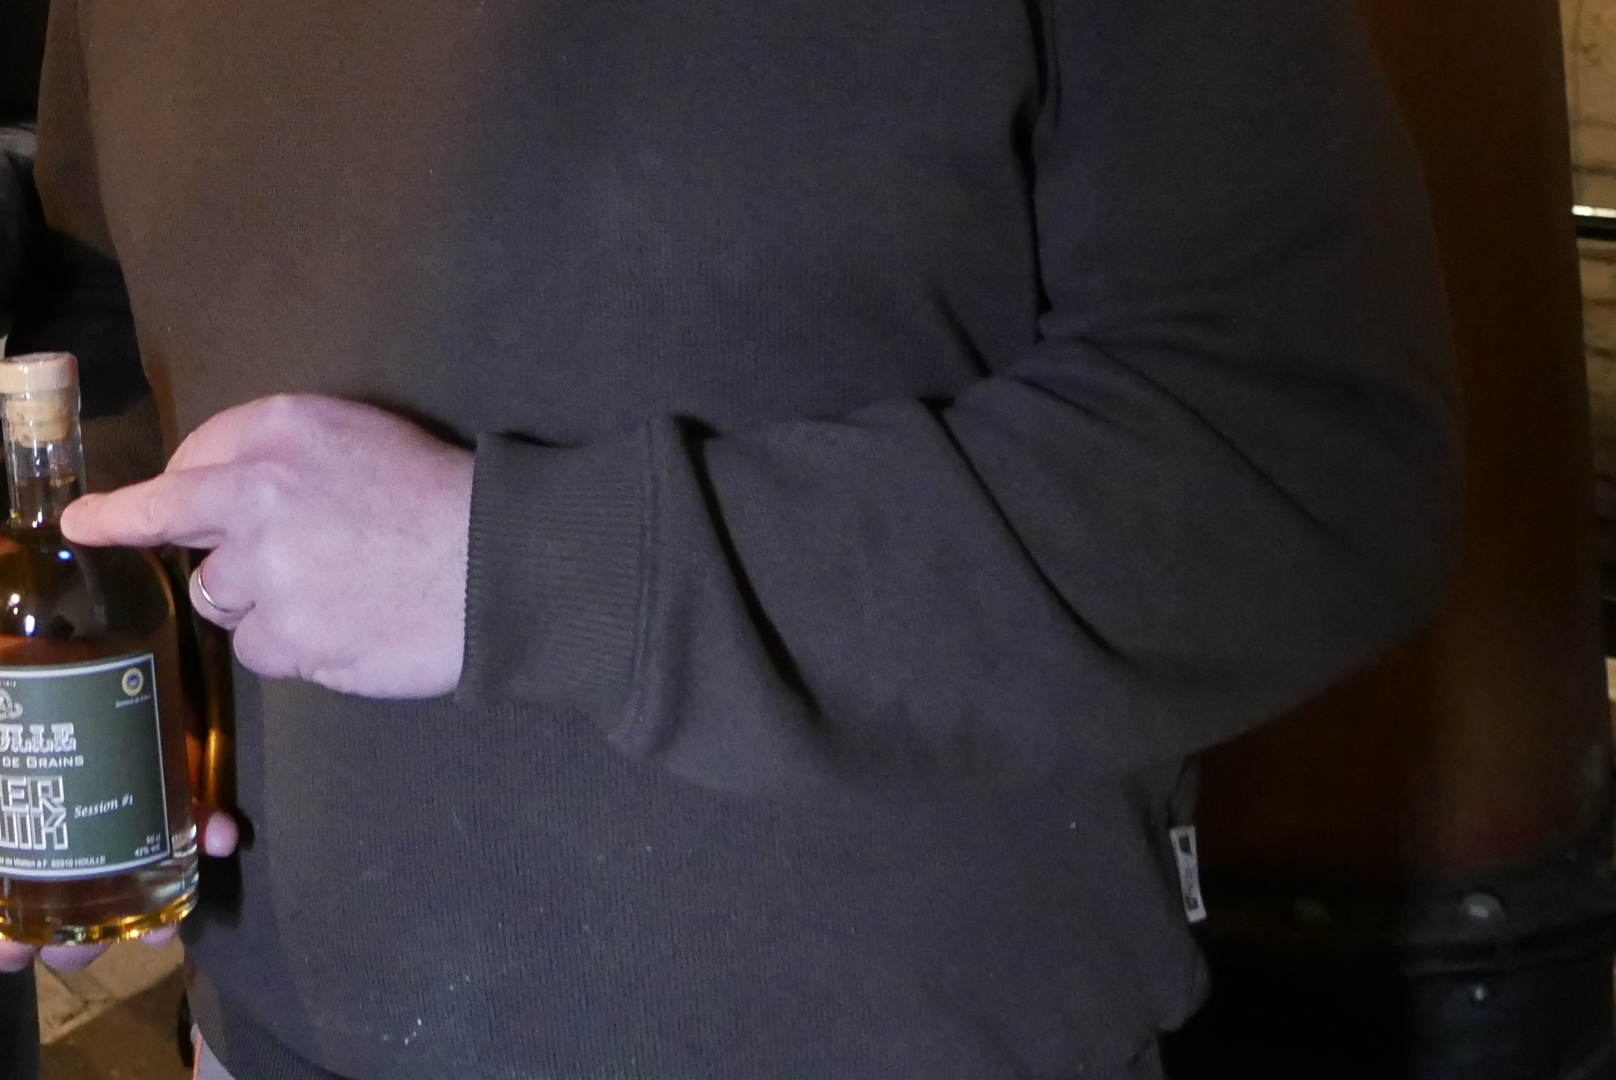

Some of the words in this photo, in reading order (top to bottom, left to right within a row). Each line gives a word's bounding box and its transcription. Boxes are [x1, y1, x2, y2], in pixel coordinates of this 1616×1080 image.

[2, 756, 20, 768] DE
[26, 755, 84, 768] GRAINS
[74, 796, 119, 819] Session
